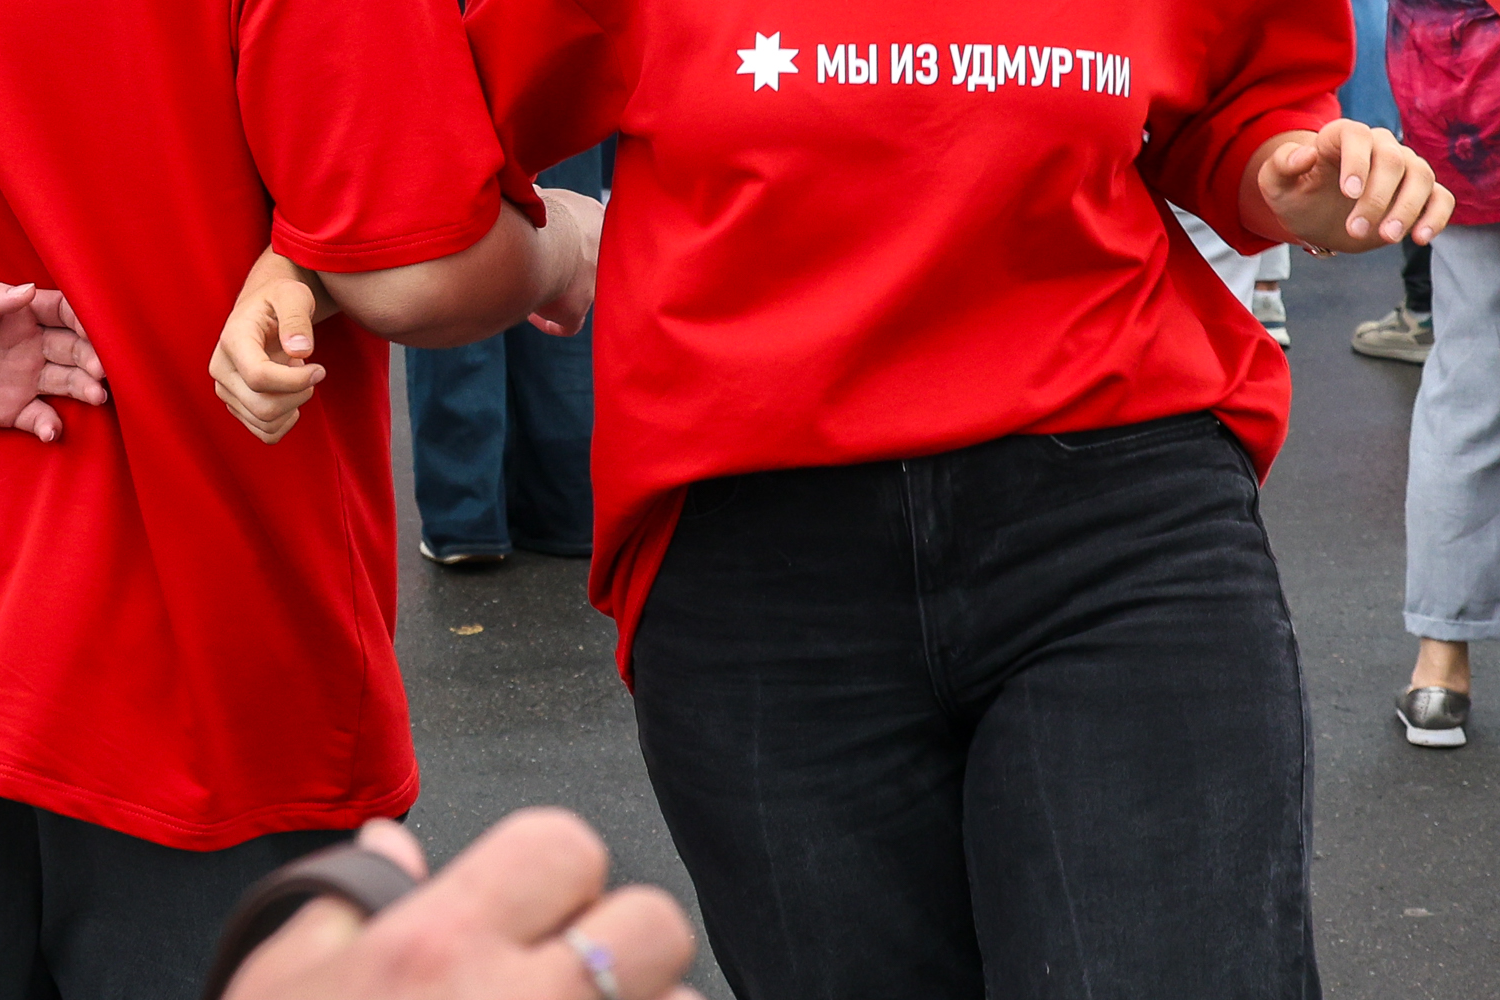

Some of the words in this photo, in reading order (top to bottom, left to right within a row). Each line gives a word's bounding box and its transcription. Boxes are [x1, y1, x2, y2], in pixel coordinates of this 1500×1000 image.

[816, 43, 878, 85] МЫ
[890, 43, 939, 85] ИЗ
[949, 43, 1131, 98] УДМУРТИИ
